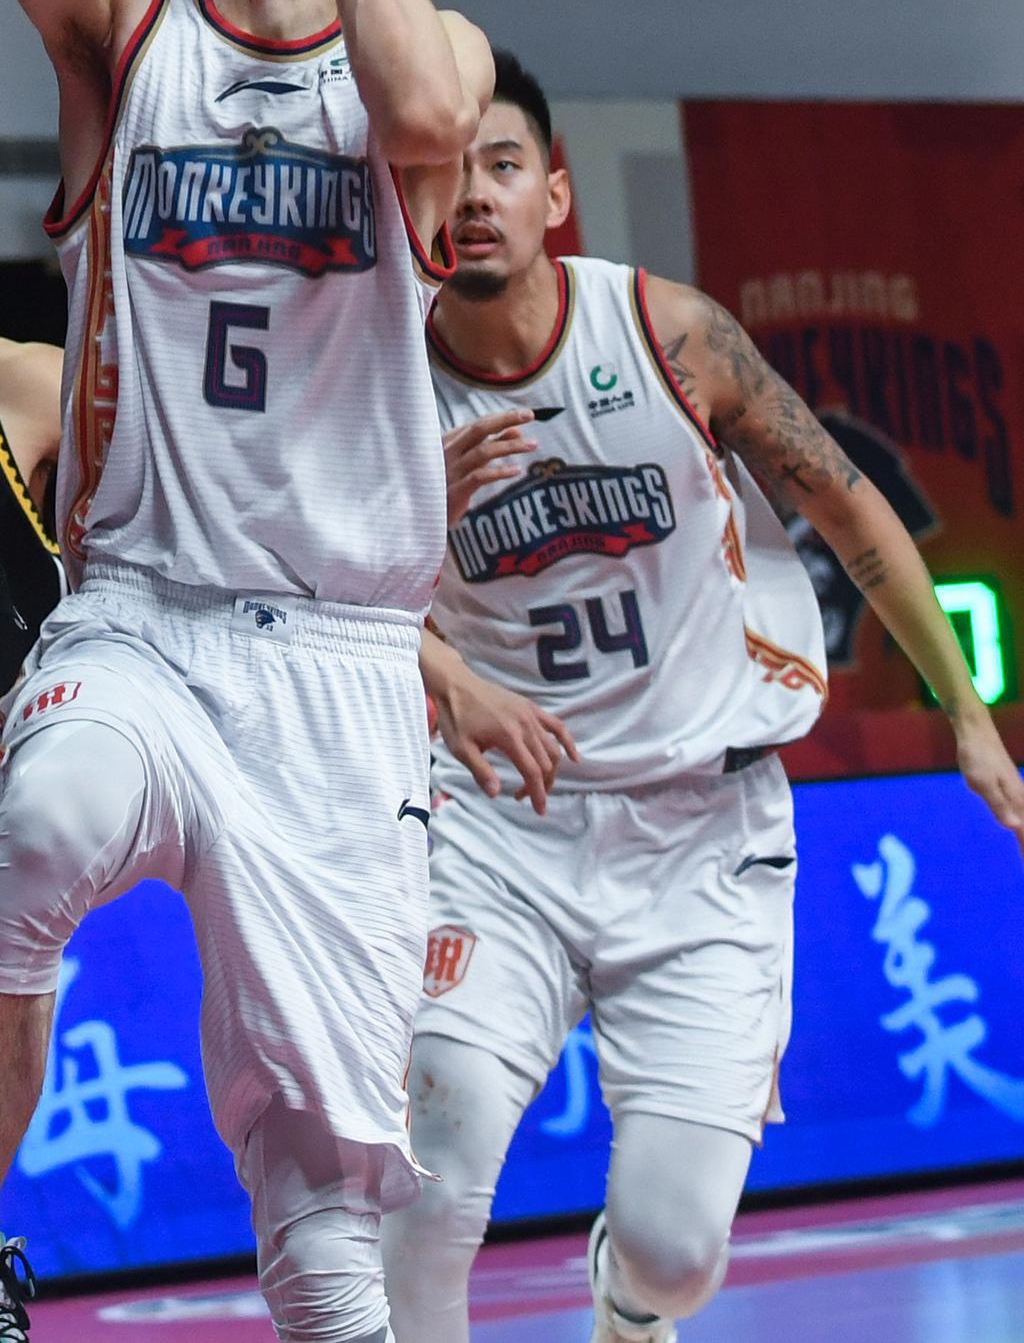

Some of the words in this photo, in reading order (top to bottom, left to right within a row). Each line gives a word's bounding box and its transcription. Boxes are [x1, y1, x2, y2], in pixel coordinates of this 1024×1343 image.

[126, 151, 376, 258] MONKEYKINGS
[202, 300, 271, 414] 6
[449, 466, 674, 580] MONKEYKINGS
[527, 589, 650, 682] 24
